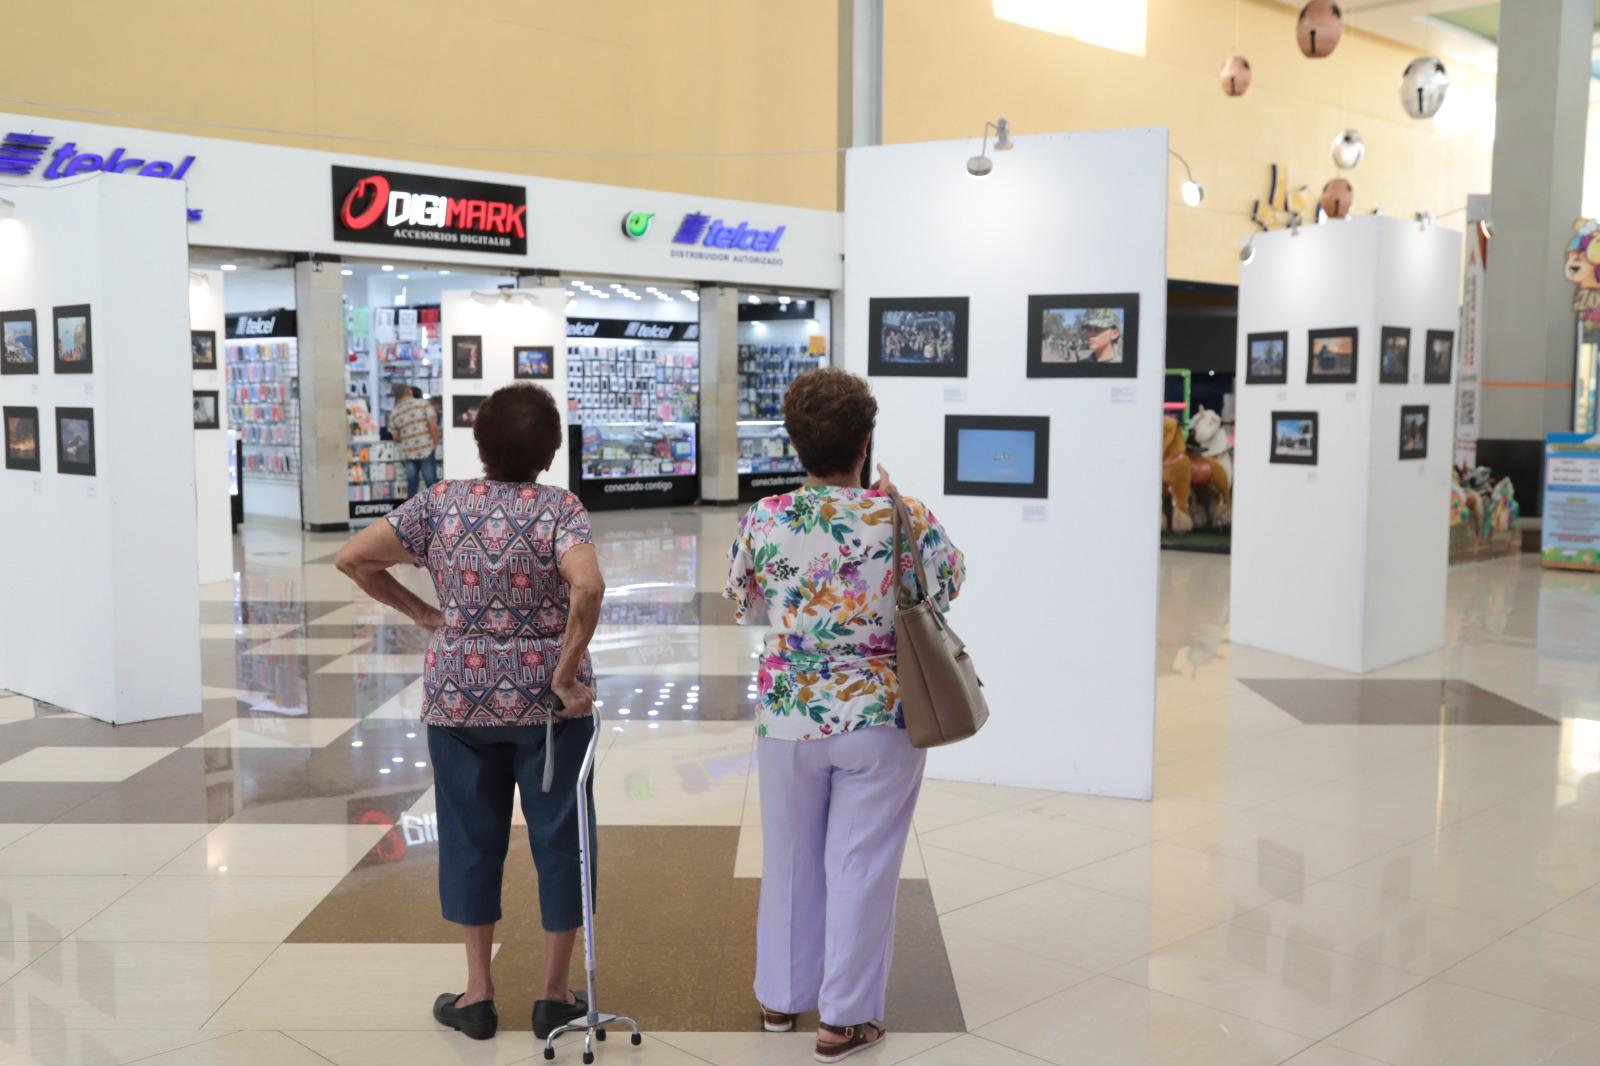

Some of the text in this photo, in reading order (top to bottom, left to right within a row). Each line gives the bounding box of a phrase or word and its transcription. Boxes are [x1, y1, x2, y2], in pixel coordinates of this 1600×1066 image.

[387, 191, 526, 238] DIGIMARK
[394, 229, 511, 247] ACCESORIOS DIGITALES
[702, 218, 786, 253] telcel
[670, 250, 783, 267] DISTRIBUIDOR AUTORIZADO
[246, 316, 276, 335] telcel
[566, 321, 600, 337] elcel
[636, 324, 674, 339] telcel
[604, 480, 673, 493] conectado contigo
